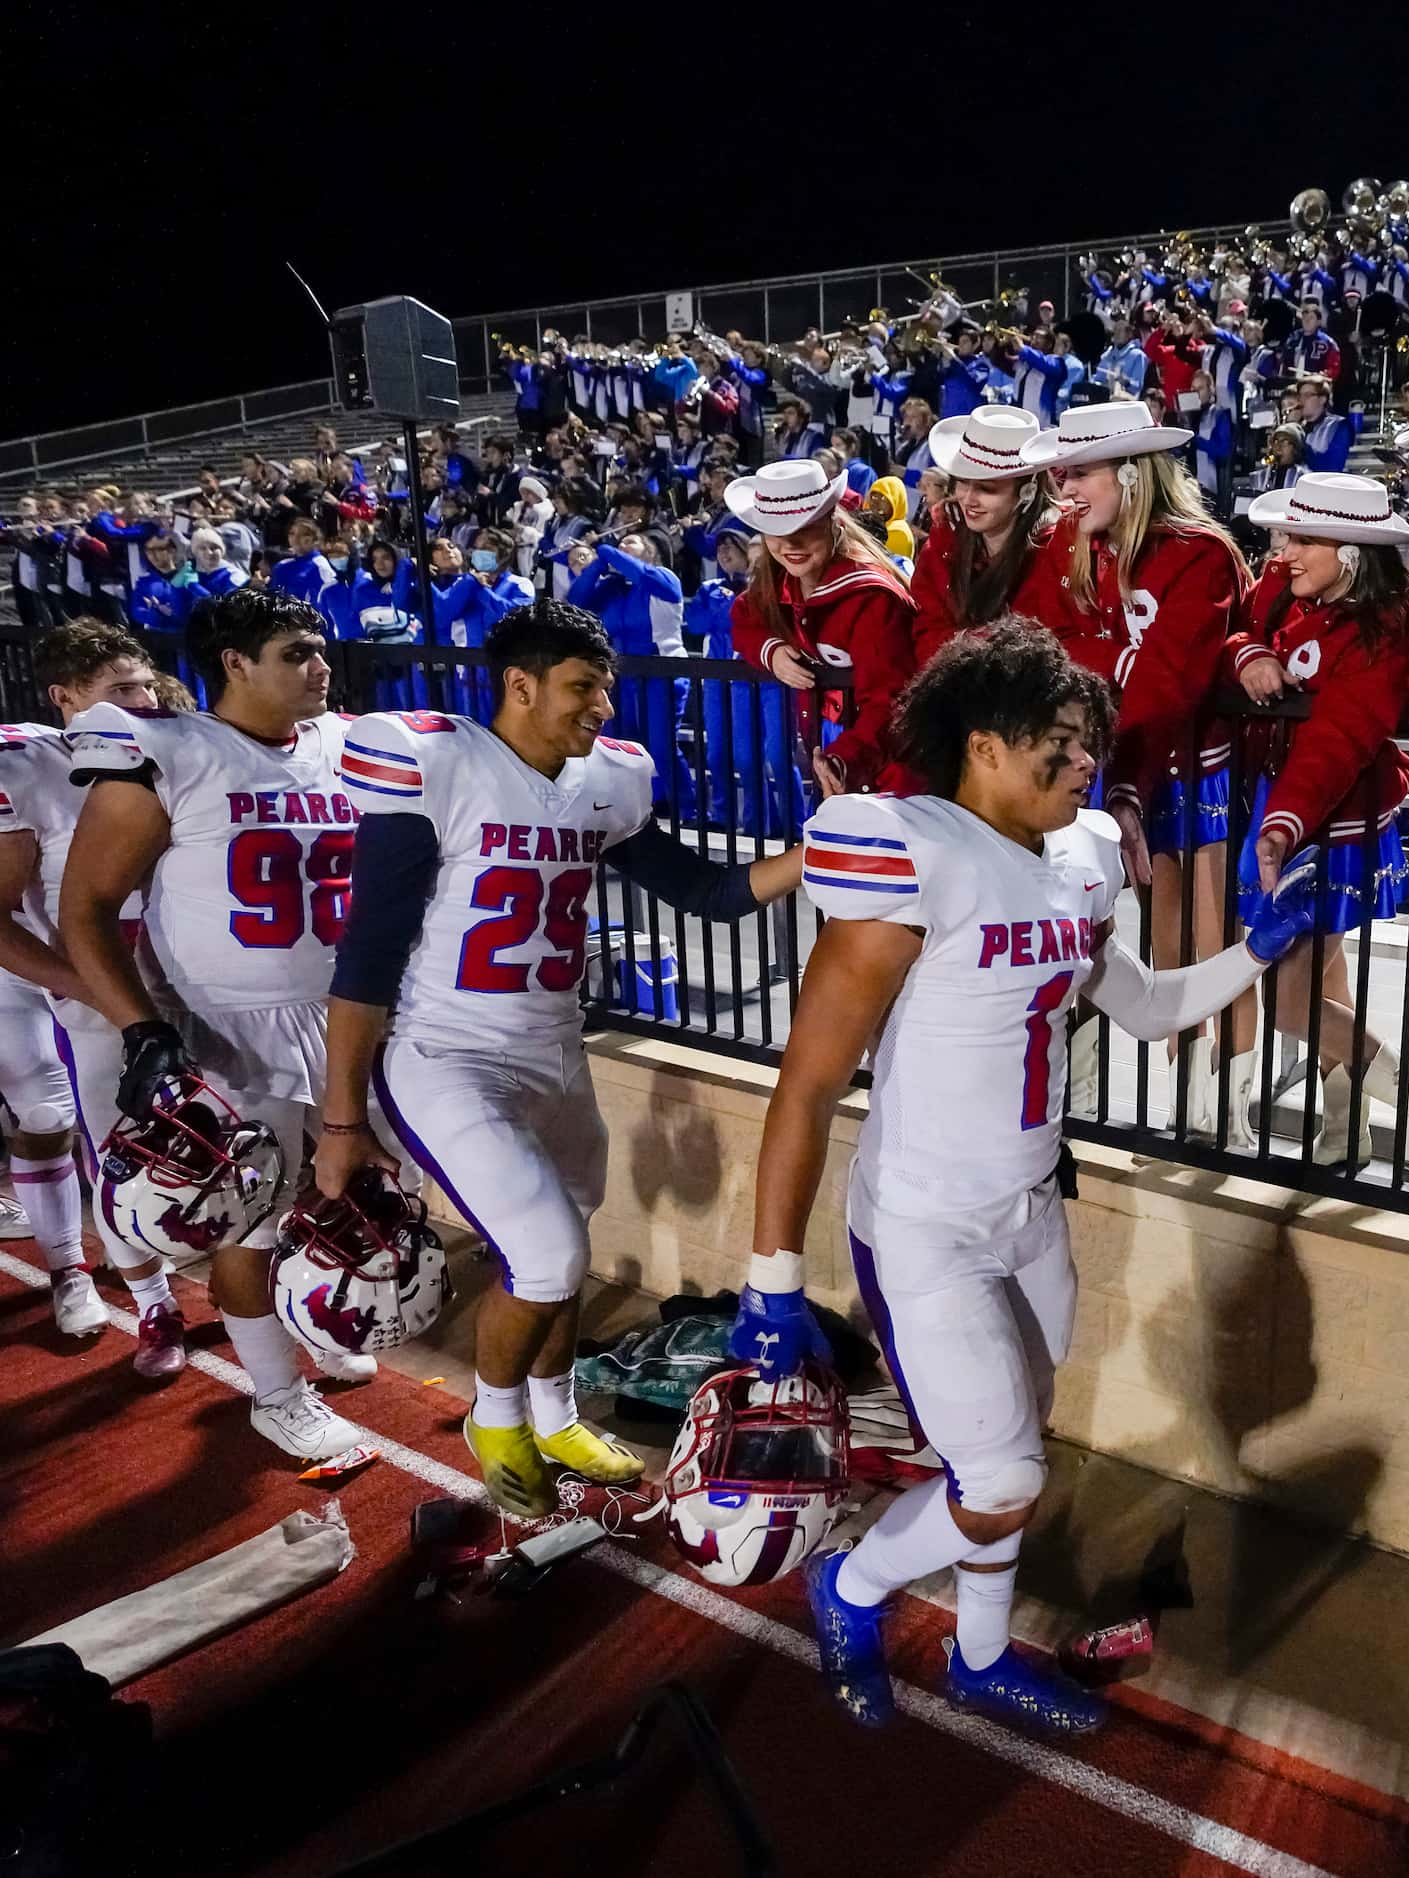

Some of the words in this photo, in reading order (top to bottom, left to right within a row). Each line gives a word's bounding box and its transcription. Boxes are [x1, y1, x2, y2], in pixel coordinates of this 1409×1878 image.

[1311, 340, 1328, 358] P
[227, 828, 355, 950] 98
[454, 865, 593, 993] 29
[1019, 970, 1075, 1132] 1
